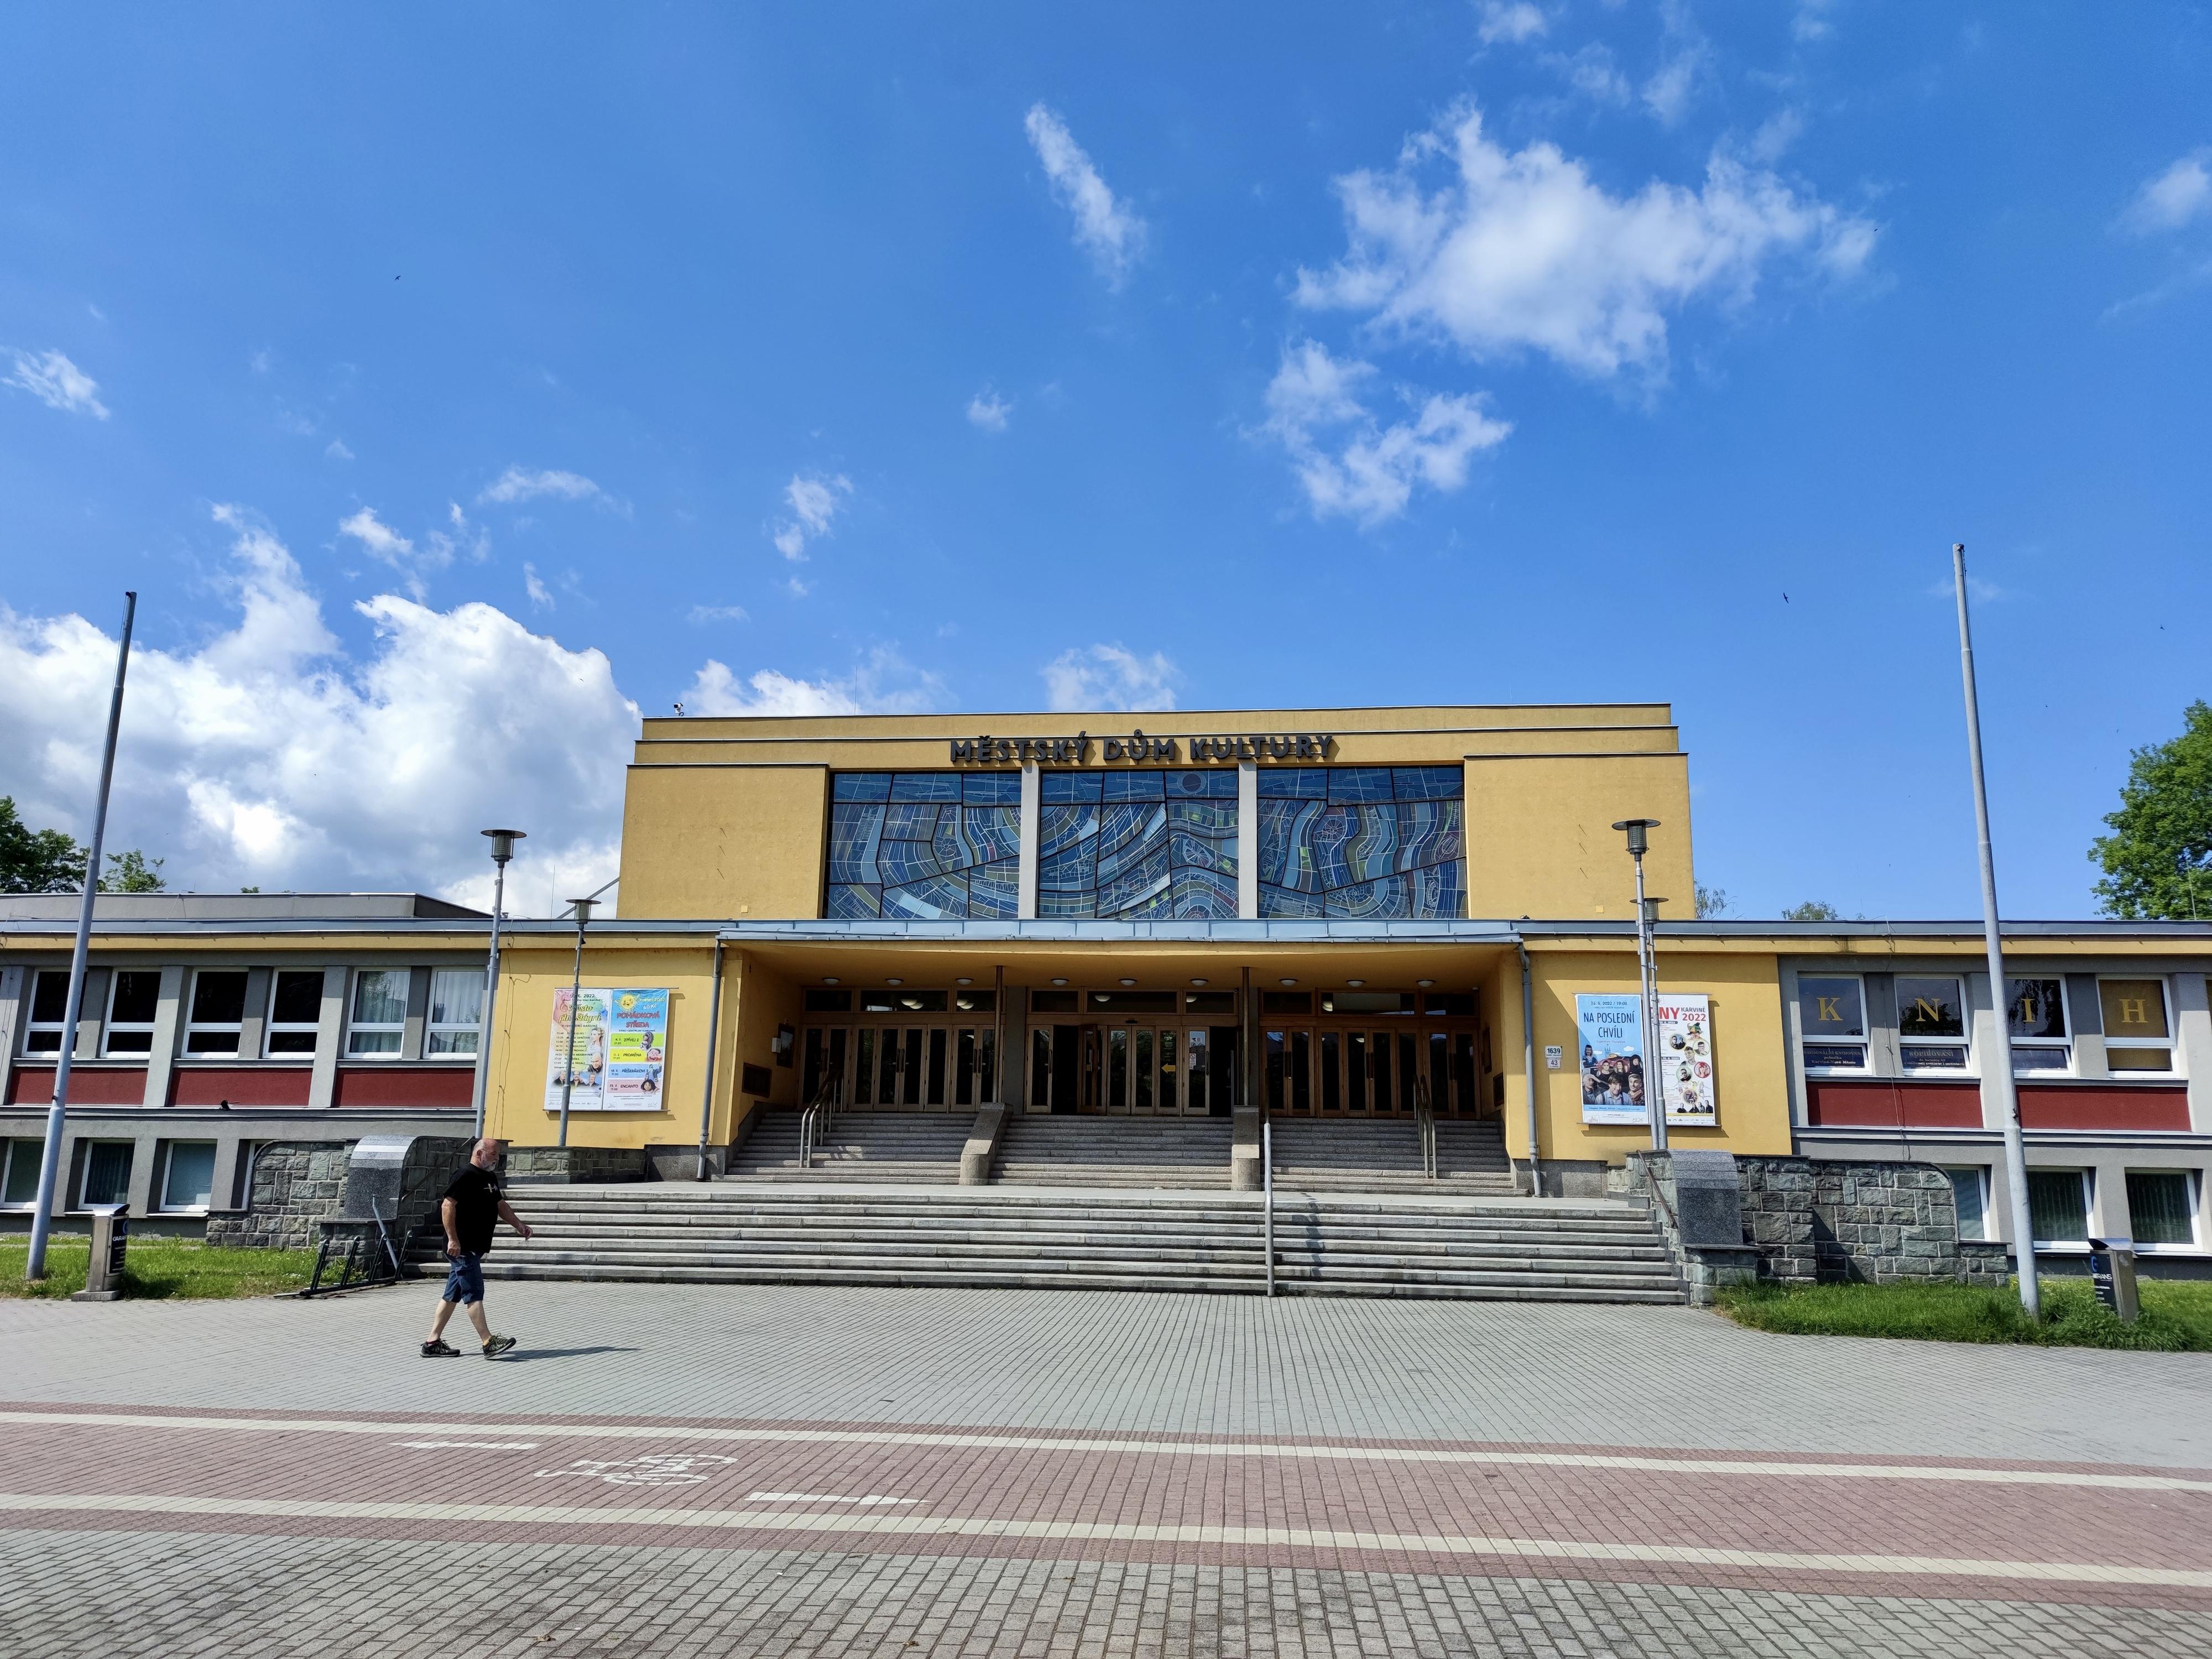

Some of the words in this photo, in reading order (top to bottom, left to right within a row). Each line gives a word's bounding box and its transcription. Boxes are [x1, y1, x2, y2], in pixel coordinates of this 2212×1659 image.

[950, 731, 1089, 762] MĚSTSKÝ
[1103, 729, 1175, 760] DŮM
[1190, 735, 1333, 760] KULTURY
[1583, 1012, 1594, 1023] NA
[1597, 1010, 1635, 1024] POSLEDNÍ
[1651, 1006, 1681, 1020] NY
[1682, 1013, 1707, 1021] 2022
[1816, 997, 1844, 1021] K
[1913, 997, 1940, 1022] N
[2021, 998, 2037, 1023] I
[2119, 999, 2148, 1023] H
[1598, 1025, 1623, 1038] CHVÍLI
